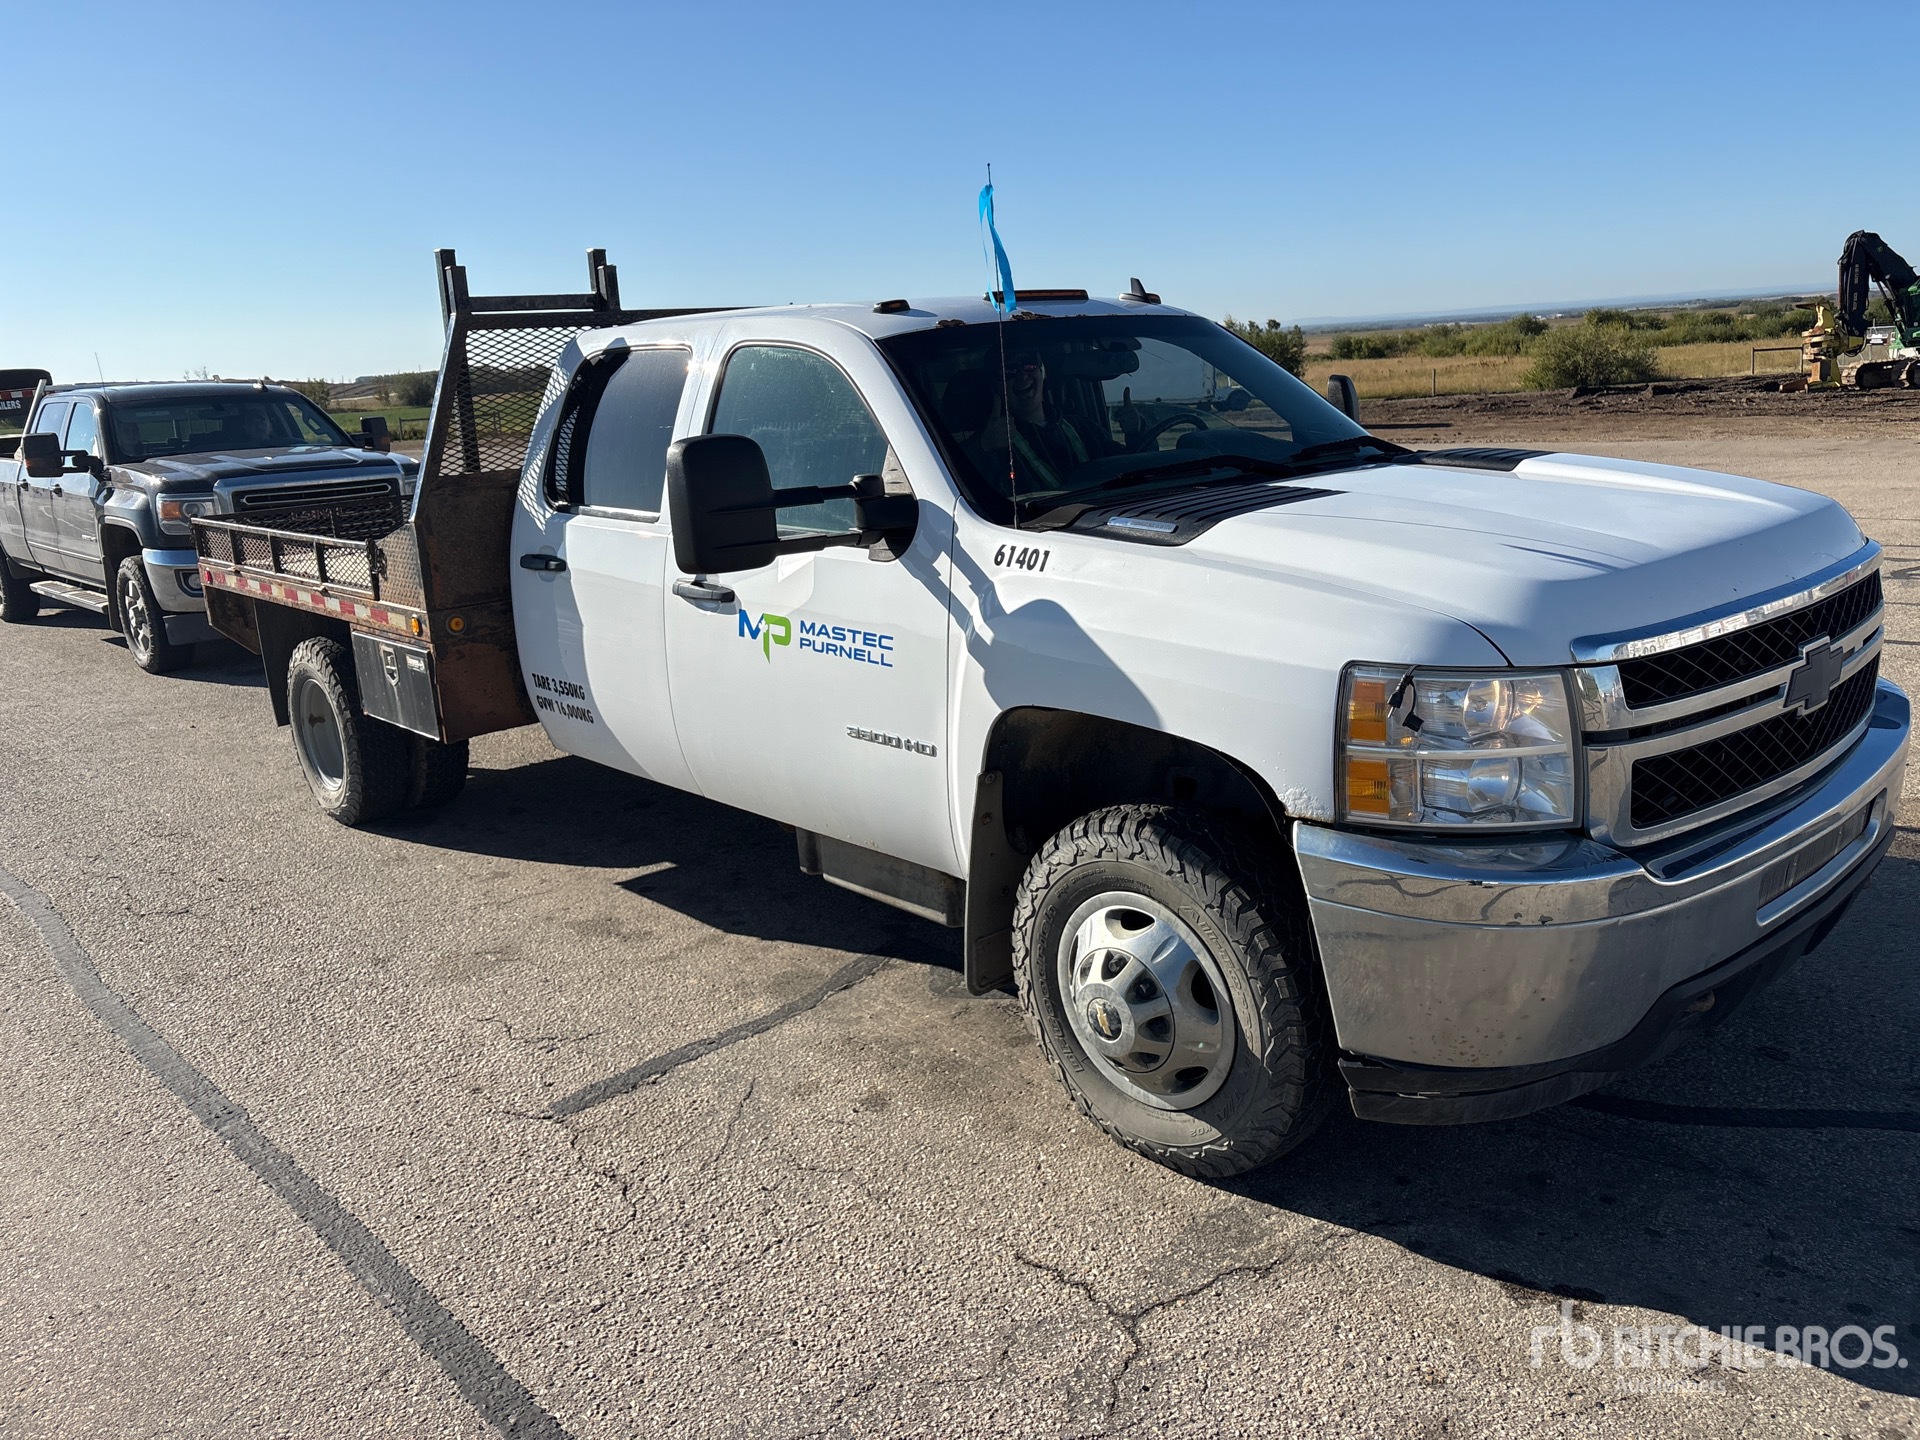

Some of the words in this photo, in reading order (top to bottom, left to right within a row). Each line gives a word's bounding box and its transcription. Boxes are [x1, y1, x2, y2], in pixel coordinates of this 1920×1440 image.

[994, 544, 1050, 572] 61401
[800, 620, 894, 651] MASTEC
[800, 637, 893, 667] PURNELL
[532, 673, 551, 691] TARE
[552, 678, 585, 701] 3,550KG
[537, 695, 555, 713] GVW
[555, 700, 594, 724] 16,000KG
[847, 725, 903, 750] 3500
[904, 738, 937, 757] HD
[1035, 903, 1085, 1073] BFGoodrich
